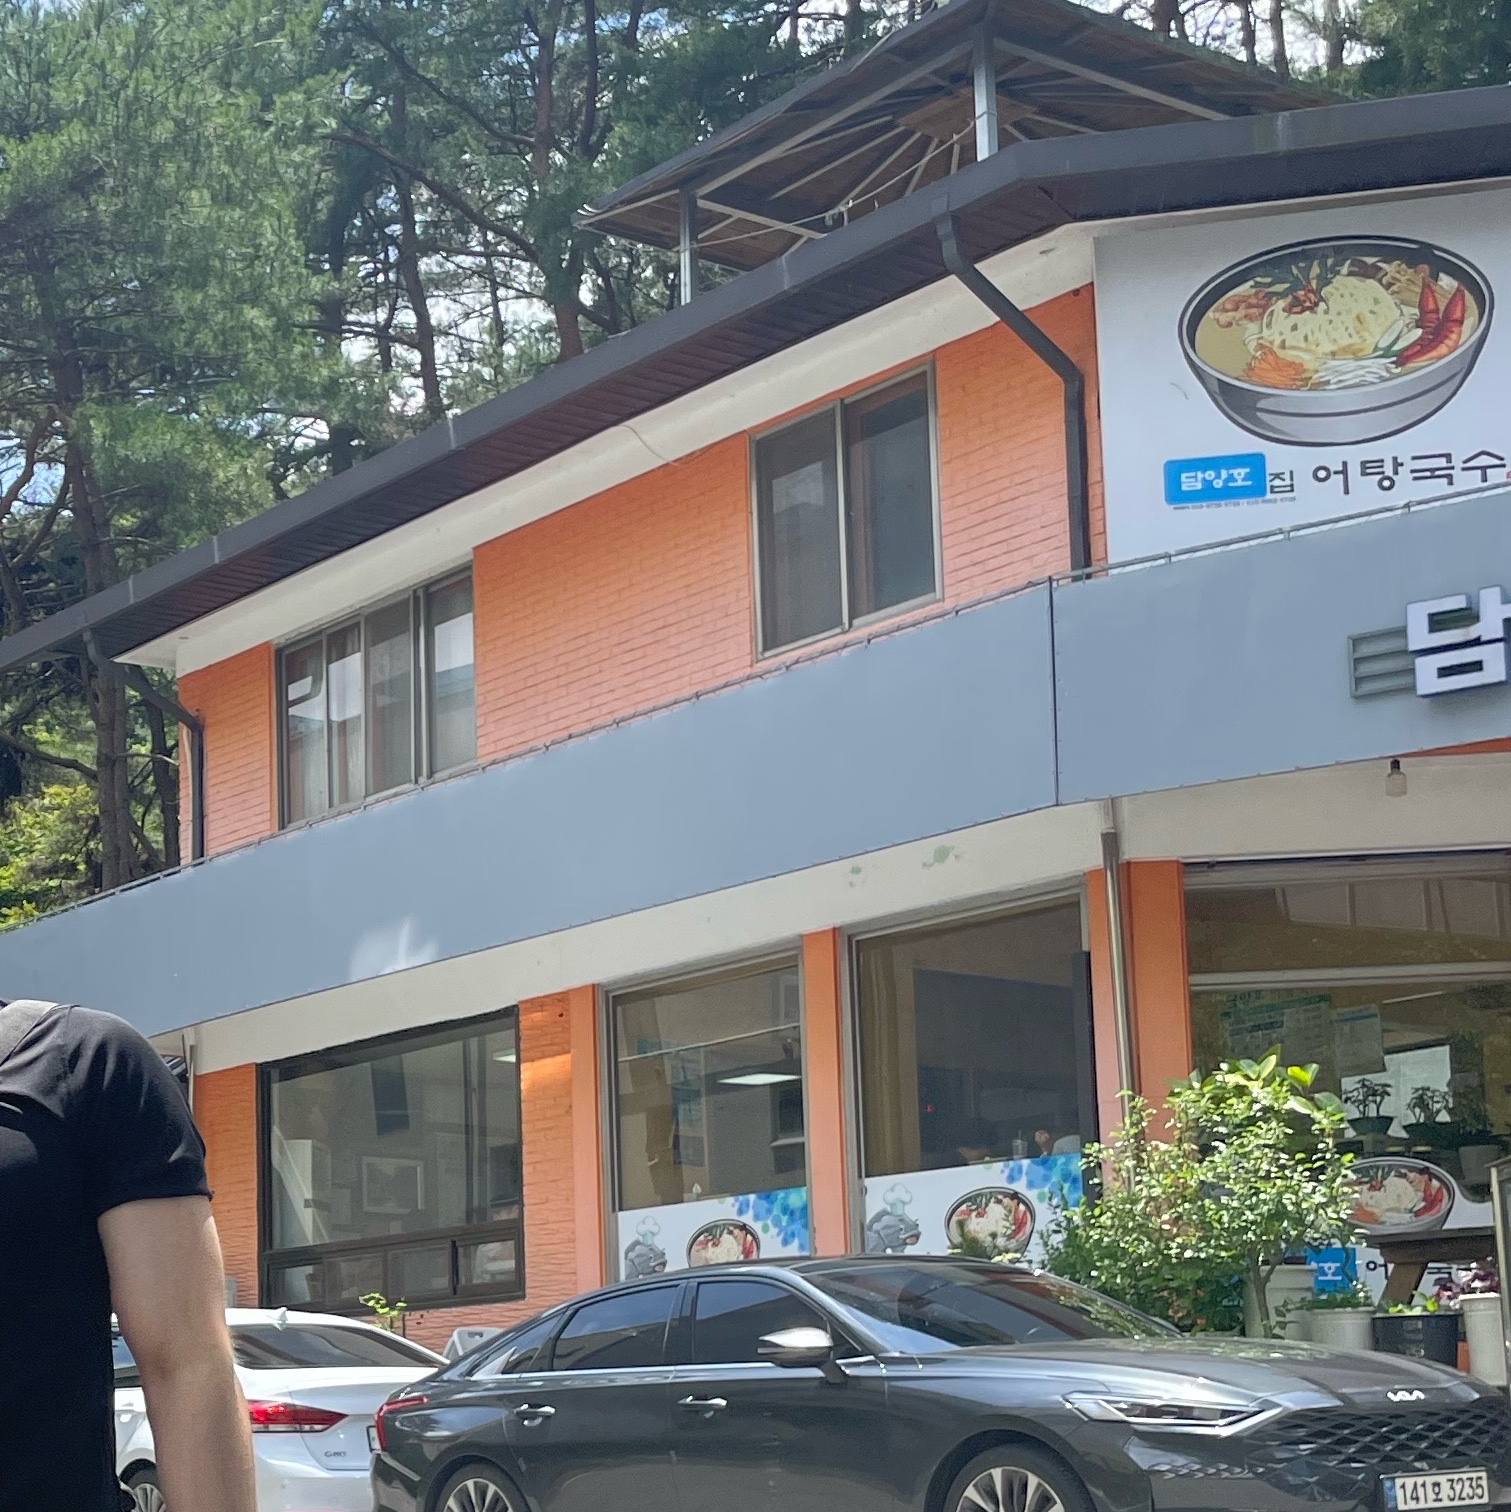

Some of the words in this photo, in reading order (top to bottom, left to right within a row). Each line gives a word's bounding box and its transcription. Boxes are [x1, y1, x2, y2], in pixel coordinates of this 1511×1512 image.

[1180, 467, 1253, 492] 담양호
[1268, 469, 1295, 495] 집
[1312, 450, 1507, 495] 어탕국수
[1446, 1476, 1485, 1502] 3235
